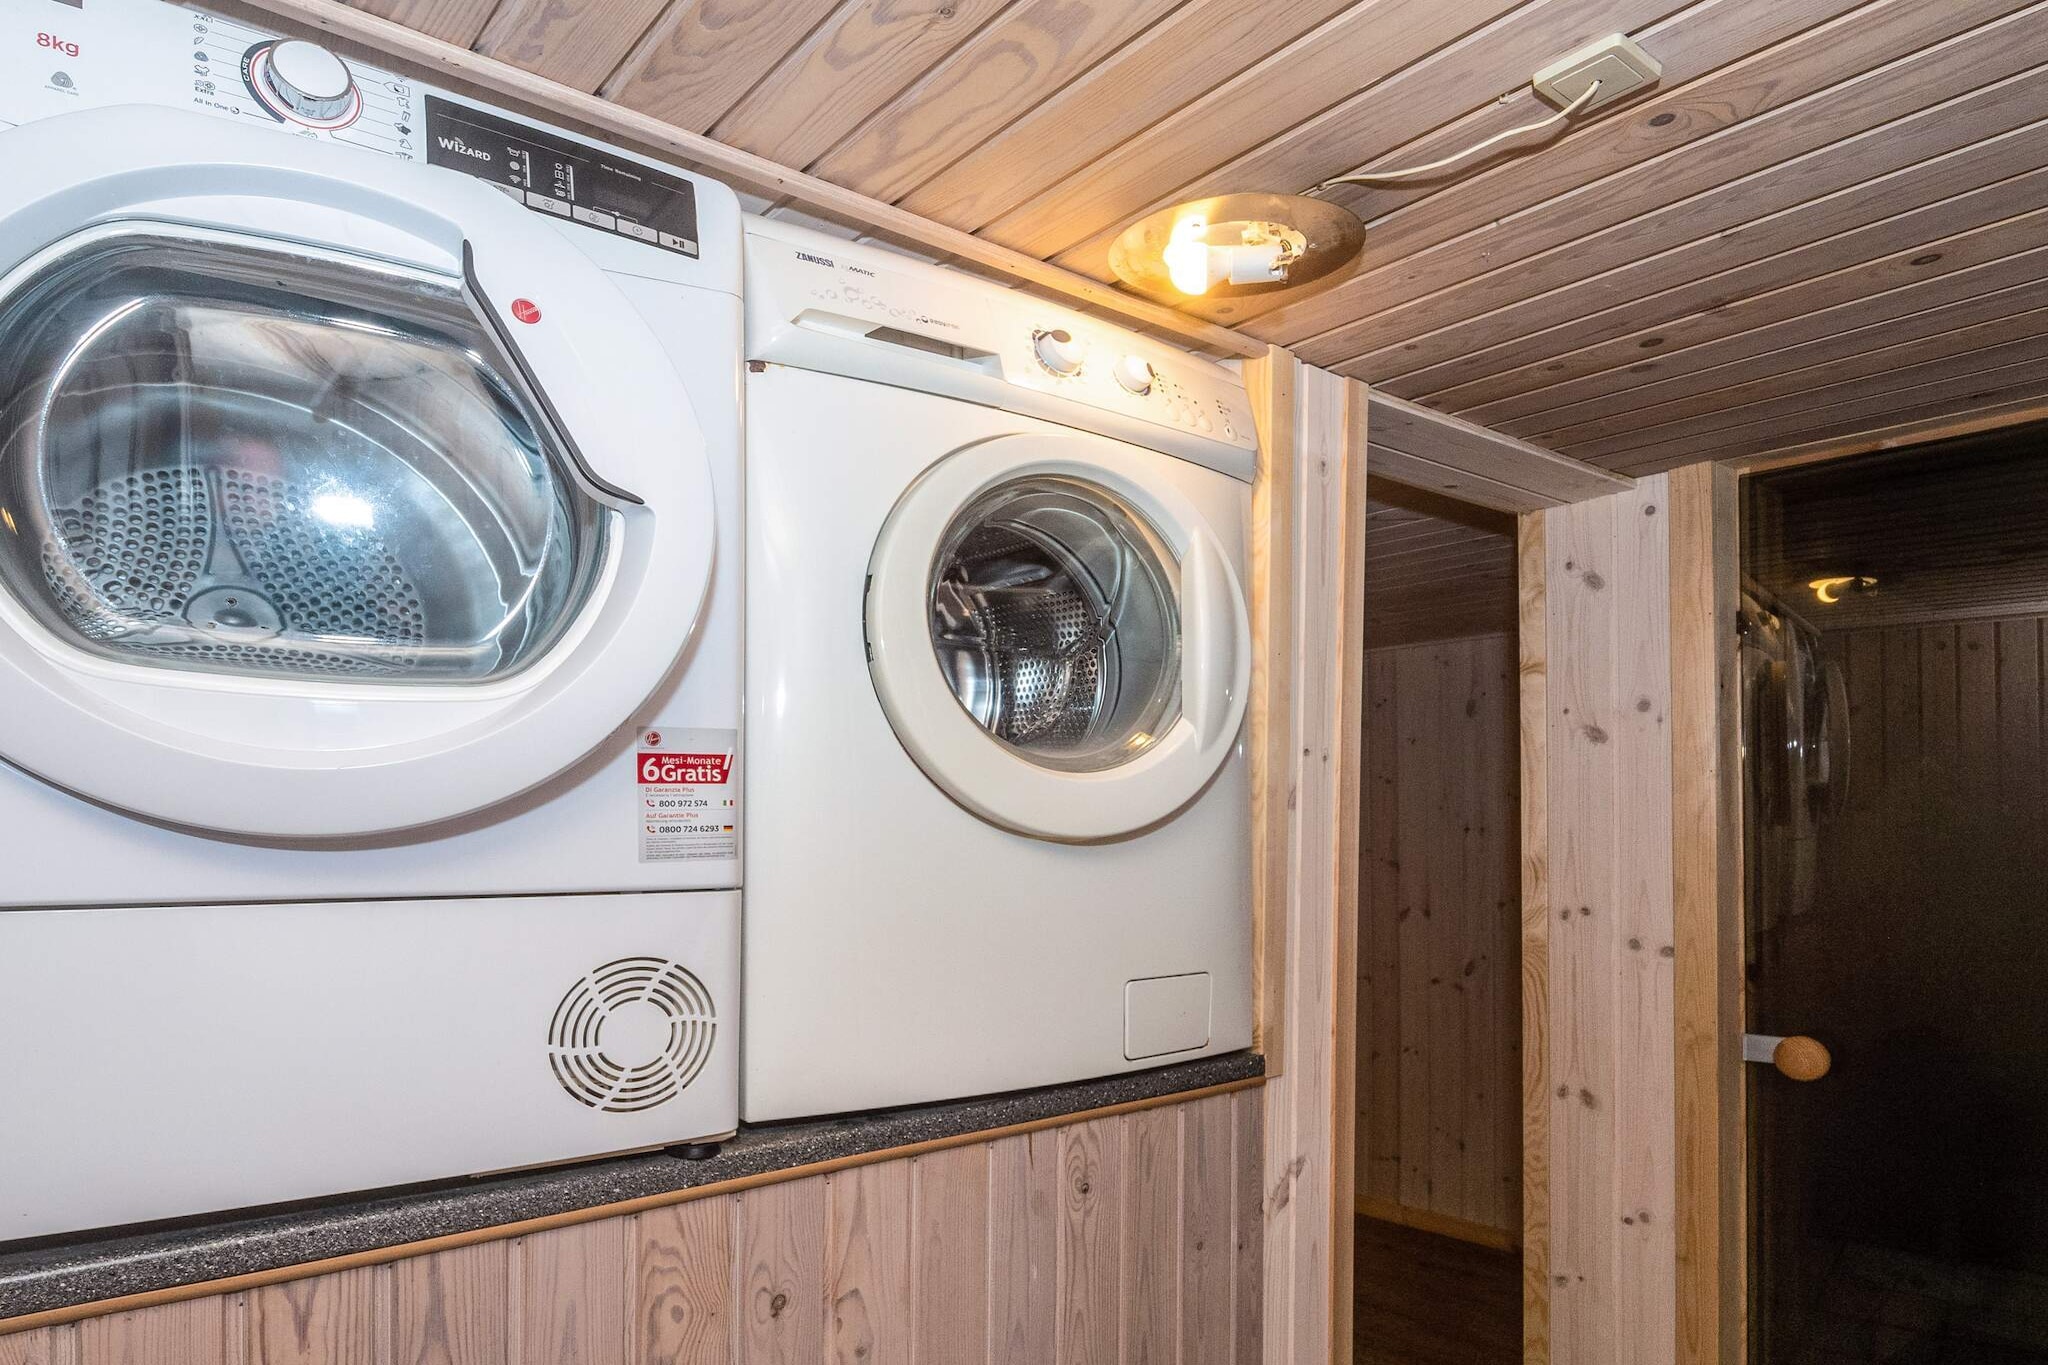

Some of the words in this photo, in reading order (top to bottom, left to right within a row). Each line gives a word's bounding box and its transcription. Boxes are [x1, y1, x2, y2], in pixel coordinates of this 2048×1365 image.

[36, 32, 80, 57] 8kg
[242, 56, 250, 82] CARE
[194, 86, 215, 96] Extra
[213, 102, 230, 111] One
[795, 251, 835, 269] ZANUSSI
[661, 756, 722, 765] Mesi-Monate
[642, 757, 660, 782] 6
[683, 825, 698, 833] 724
